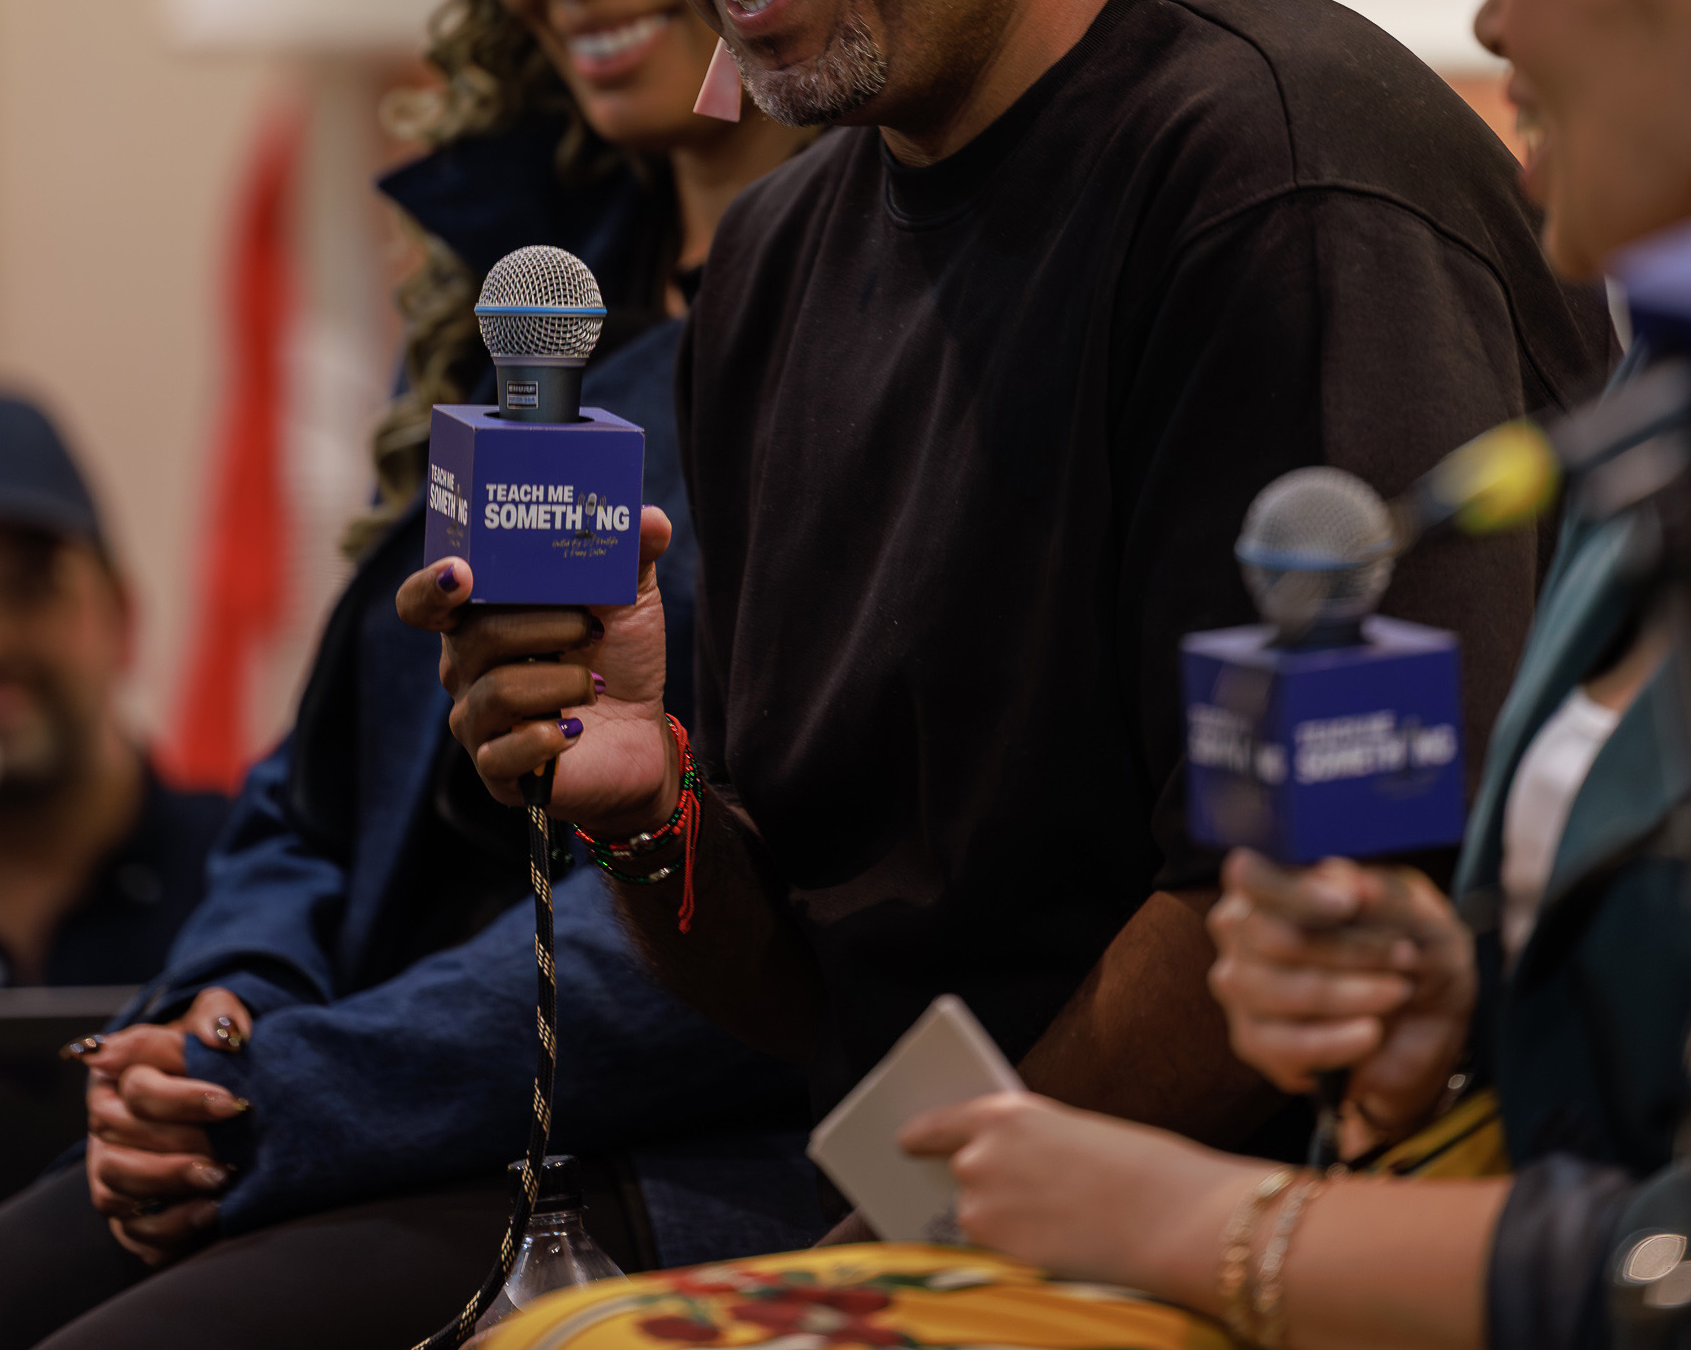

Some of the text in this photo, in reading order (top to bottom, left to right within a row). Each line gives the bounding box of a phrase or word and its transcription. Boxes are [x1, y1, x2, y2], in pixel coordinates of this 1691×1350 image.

[431, 463, 455, 491] TEACH ME
[429, 482, 468, 526] SOMETHNG
[486, 484, 574, 503] TEACH ME
[484, 503, 630, 531] SOMETHNG
